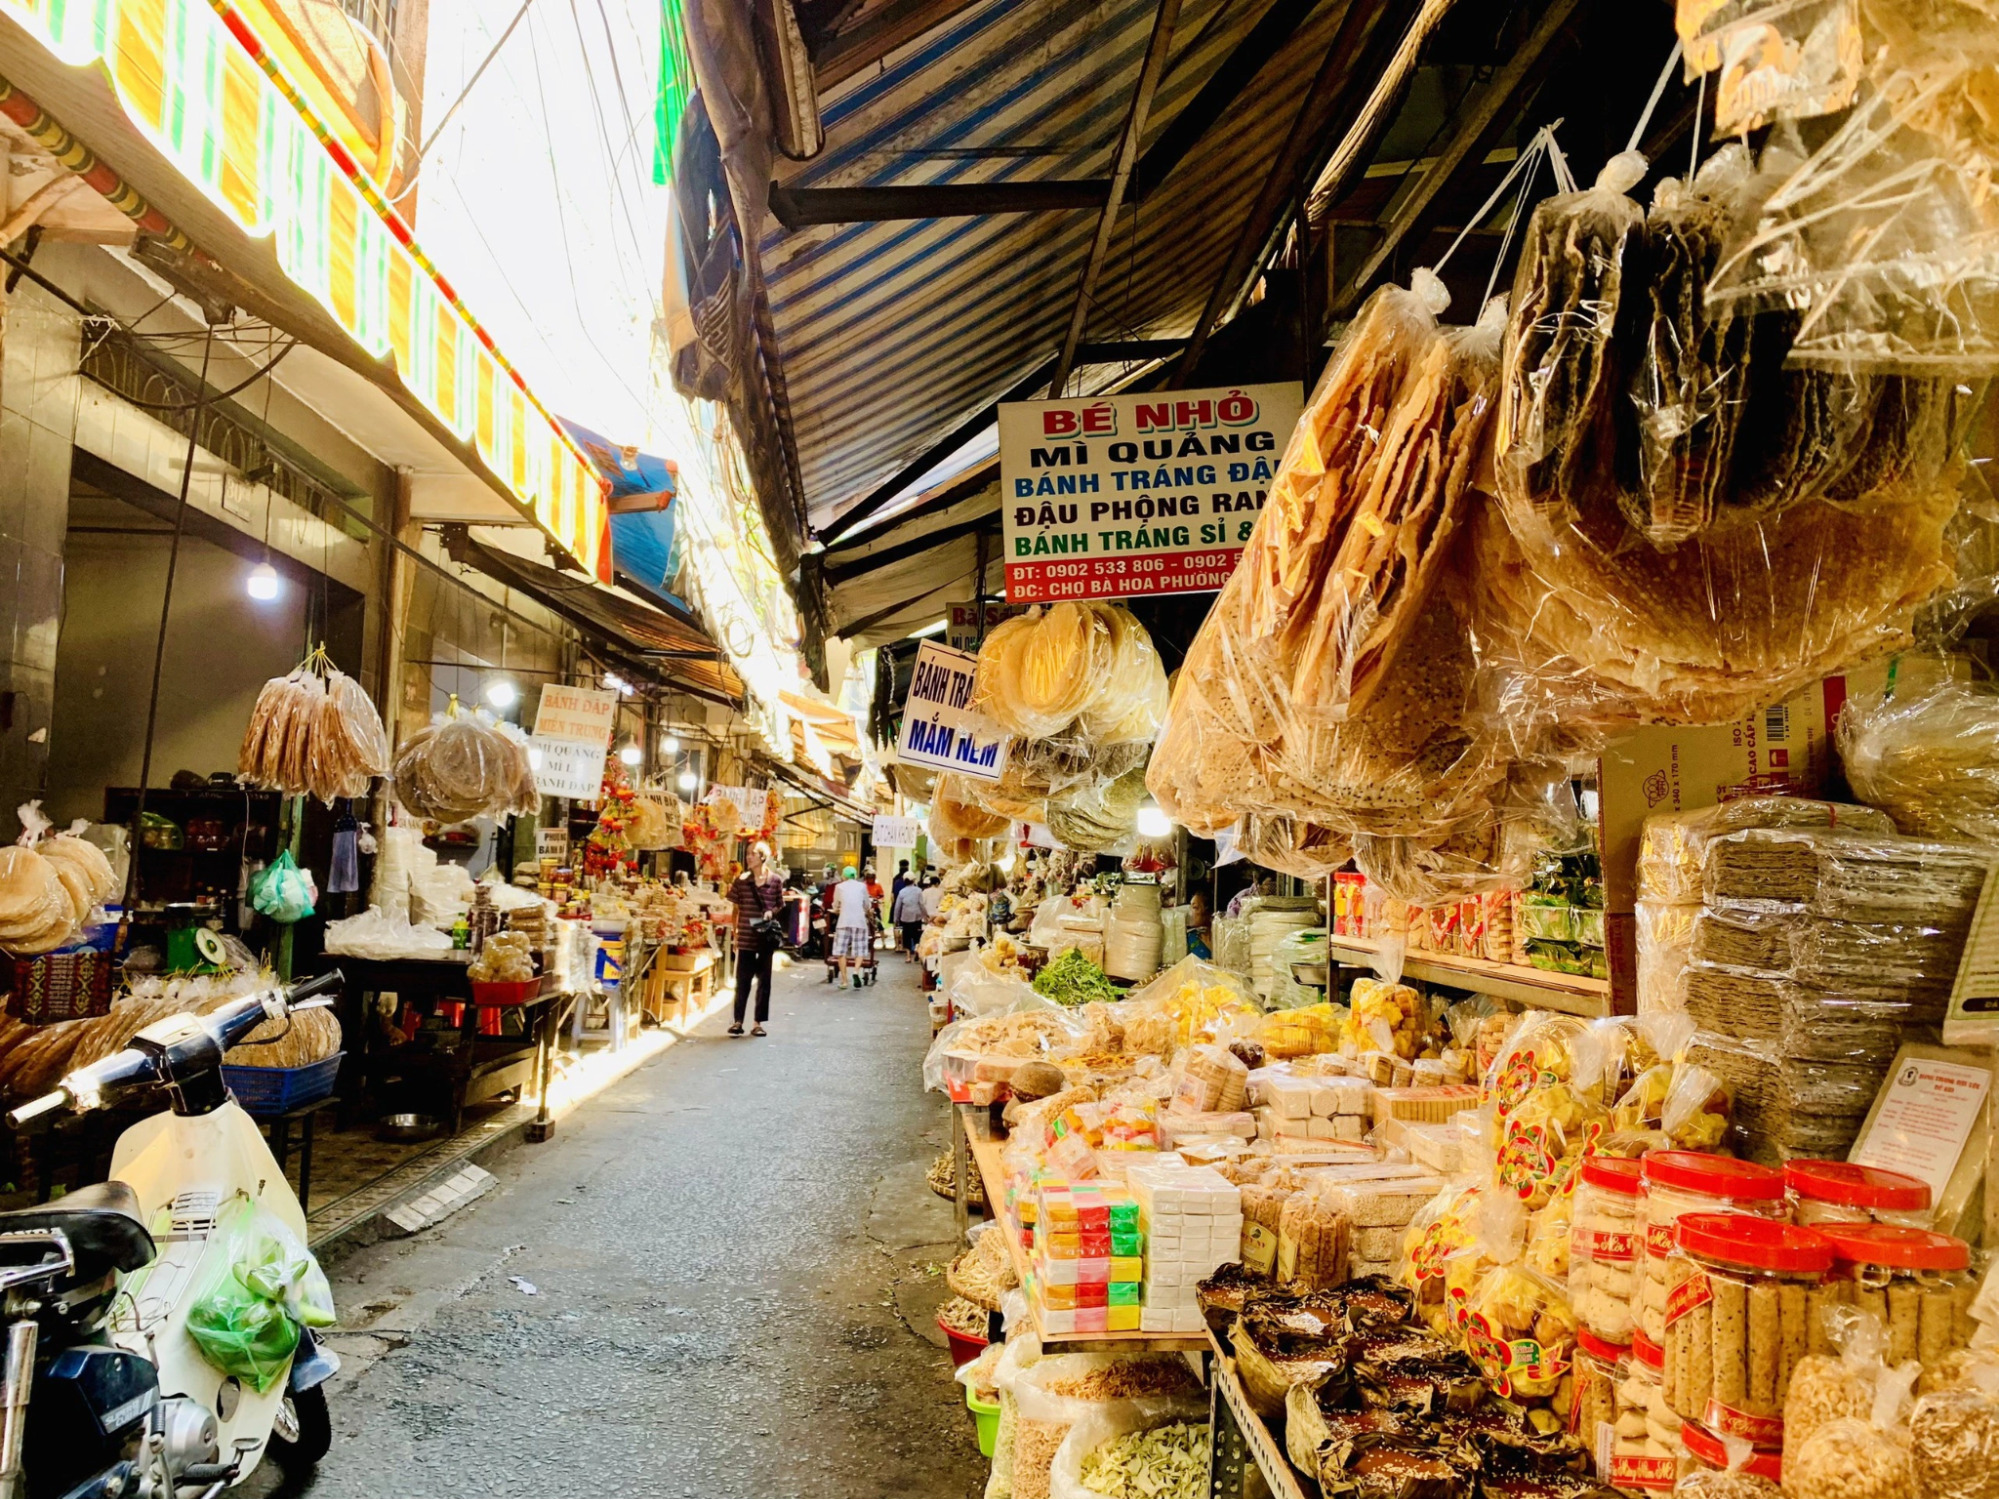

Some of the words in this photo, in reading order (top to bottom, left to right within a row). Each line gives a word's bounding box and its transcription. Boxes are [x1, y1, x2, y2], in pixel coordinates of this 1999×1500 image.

[1043, 401, 1116, 438] BÉ
[1135, 389, 1258, 433] NHỎ
[1030, 441, 1088, 467] MÌ
[1108, 430, 1275, 463] QUẢNG
[1015, 470, 1100, 498] BÁNH
[1111, 463, 1216, 491] TRÁNG
[1227, 455, 1281, 484] ĐẬ
[1014, 501, 1078, 531] ĐẬU
[1090, 494, 1200, 522] PHỘNG
[1015, 529, 1089, 557] BÁNH
[1099, 524, 1190, 551] TRÁNG
[1200, 517, 1226, 545] SỈ
[1237, 521, 1254, 542] &
[1013, 567, 1040, 581] ĐT:
[1046, 563, 1088, 580] 0902
[1094, 561, 1126, 575] 533
[1132, 558, 1164, 573] 806
[1184, 554, 1227, 569] 0902
[1013, 584, 1043, 599] ĐC:
[1050, 580, 1085, 598] CHỢ
[1090, 575, 1114, 593] BÀ
[1118, 576, 1154, 591] HOA
[912, 656, 951, 705] BÁNH
[948, 668, 977, 710] TRÁ
[543, 693, 579, 711] BÁNH
[569, 722, 606, 739] TRUNG
[907, 712, 955, 758] MẮM
[1733, 729, 1742, 746] ISO
[1743, 725, 1756, 748] CẤP
[1671, 744, 1678, 761] mm
[1748, 751, 1757, 774] CAO
